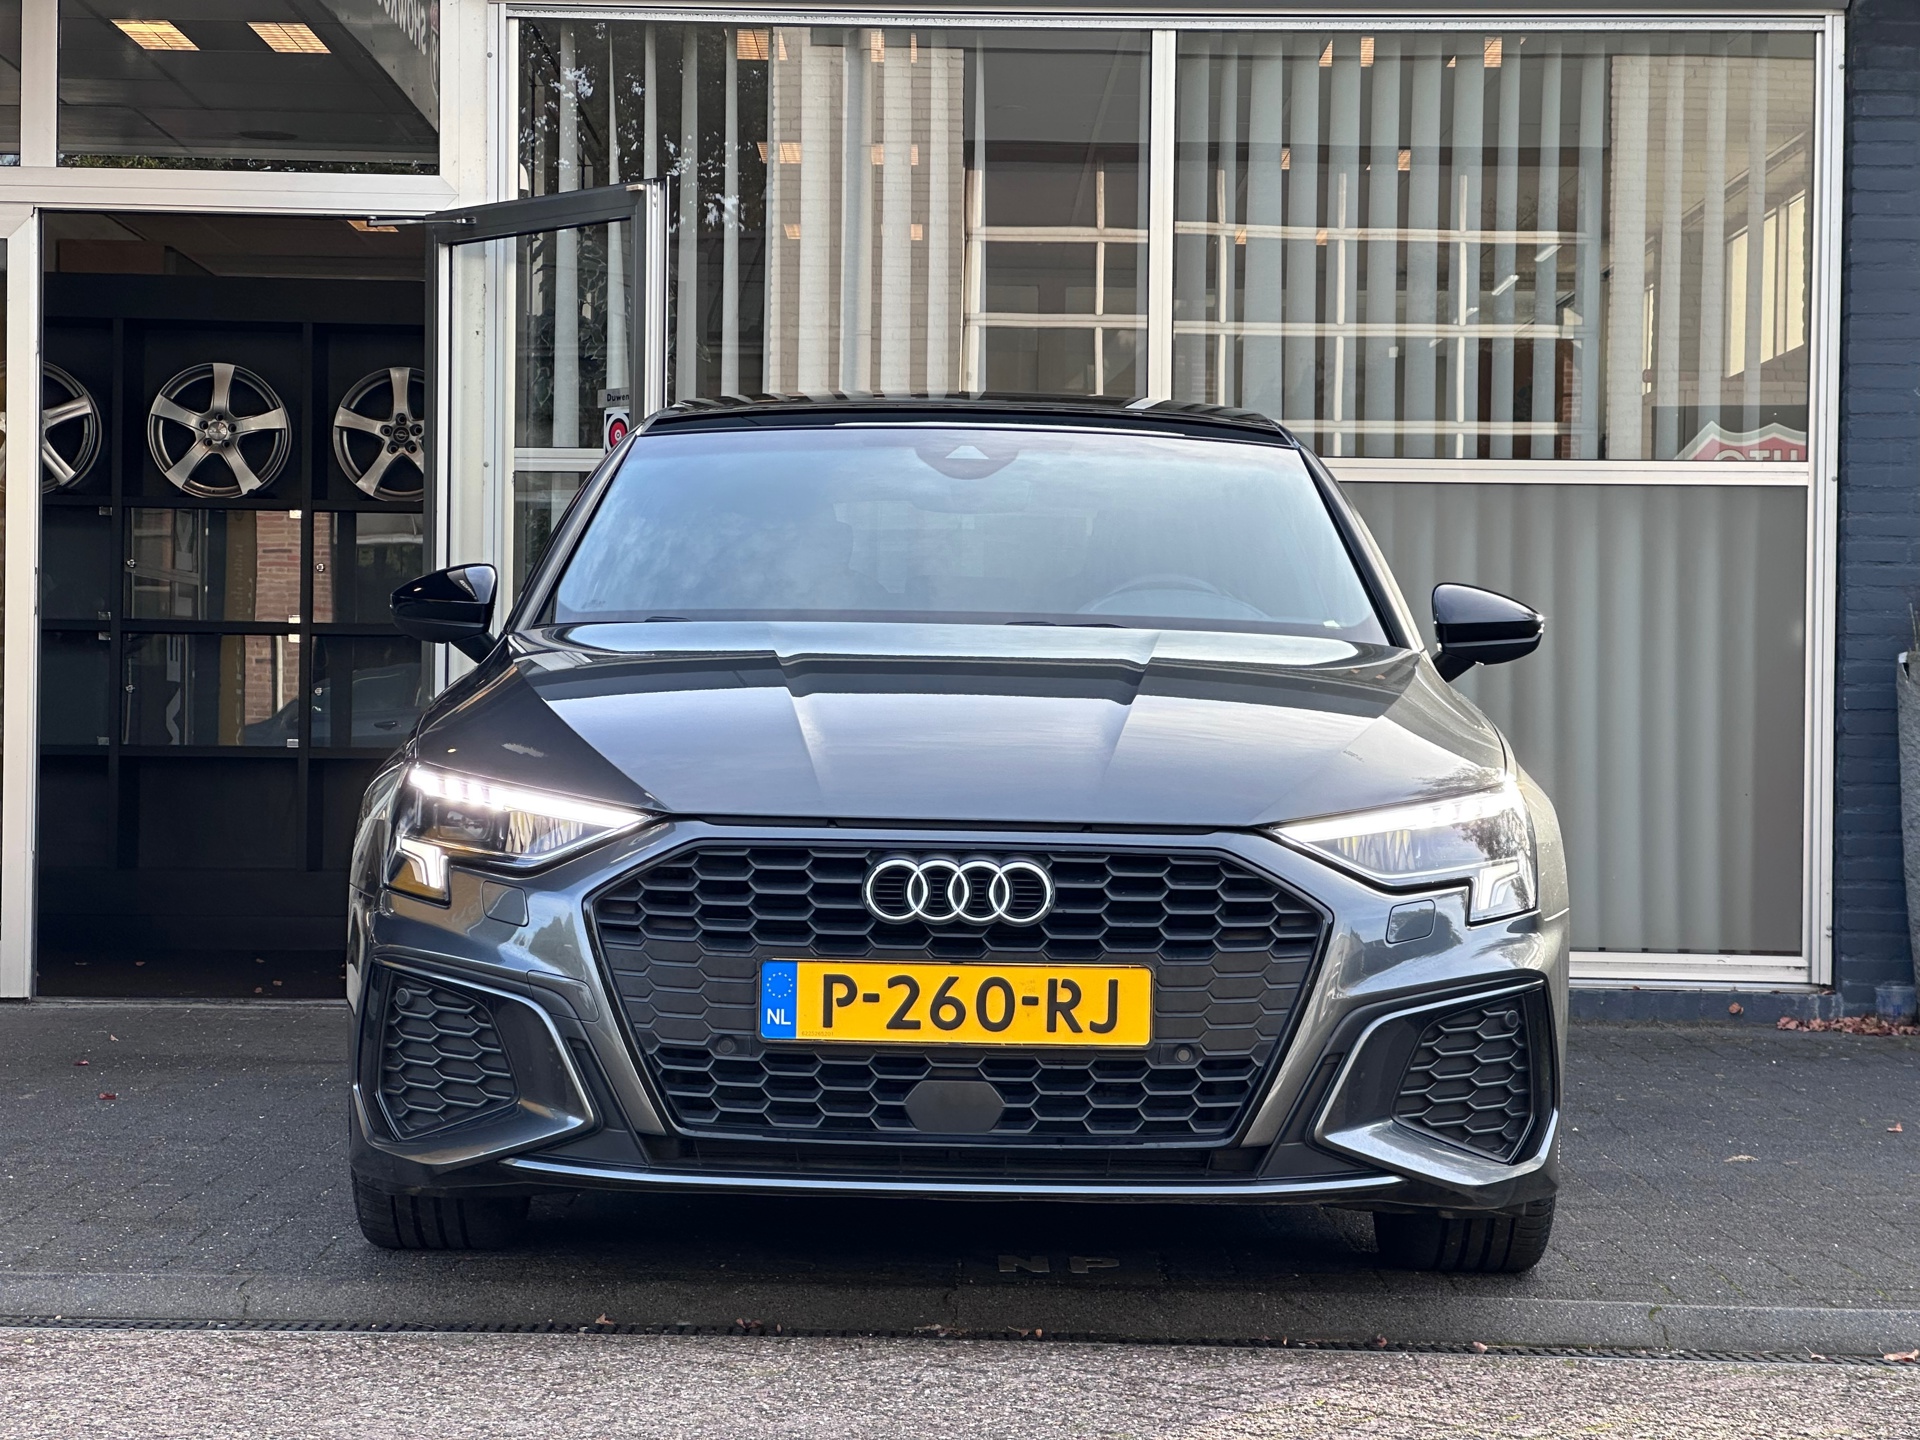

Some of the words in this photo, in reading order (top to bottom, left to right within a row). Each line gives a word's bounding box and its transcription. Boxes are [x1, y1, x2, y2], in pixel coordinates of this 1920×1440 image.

[606, 393, 629, 402] Duwen
[822, 973, 1119, 1034] P-260-RJ
[767, 1008, 791, 1025] NL
